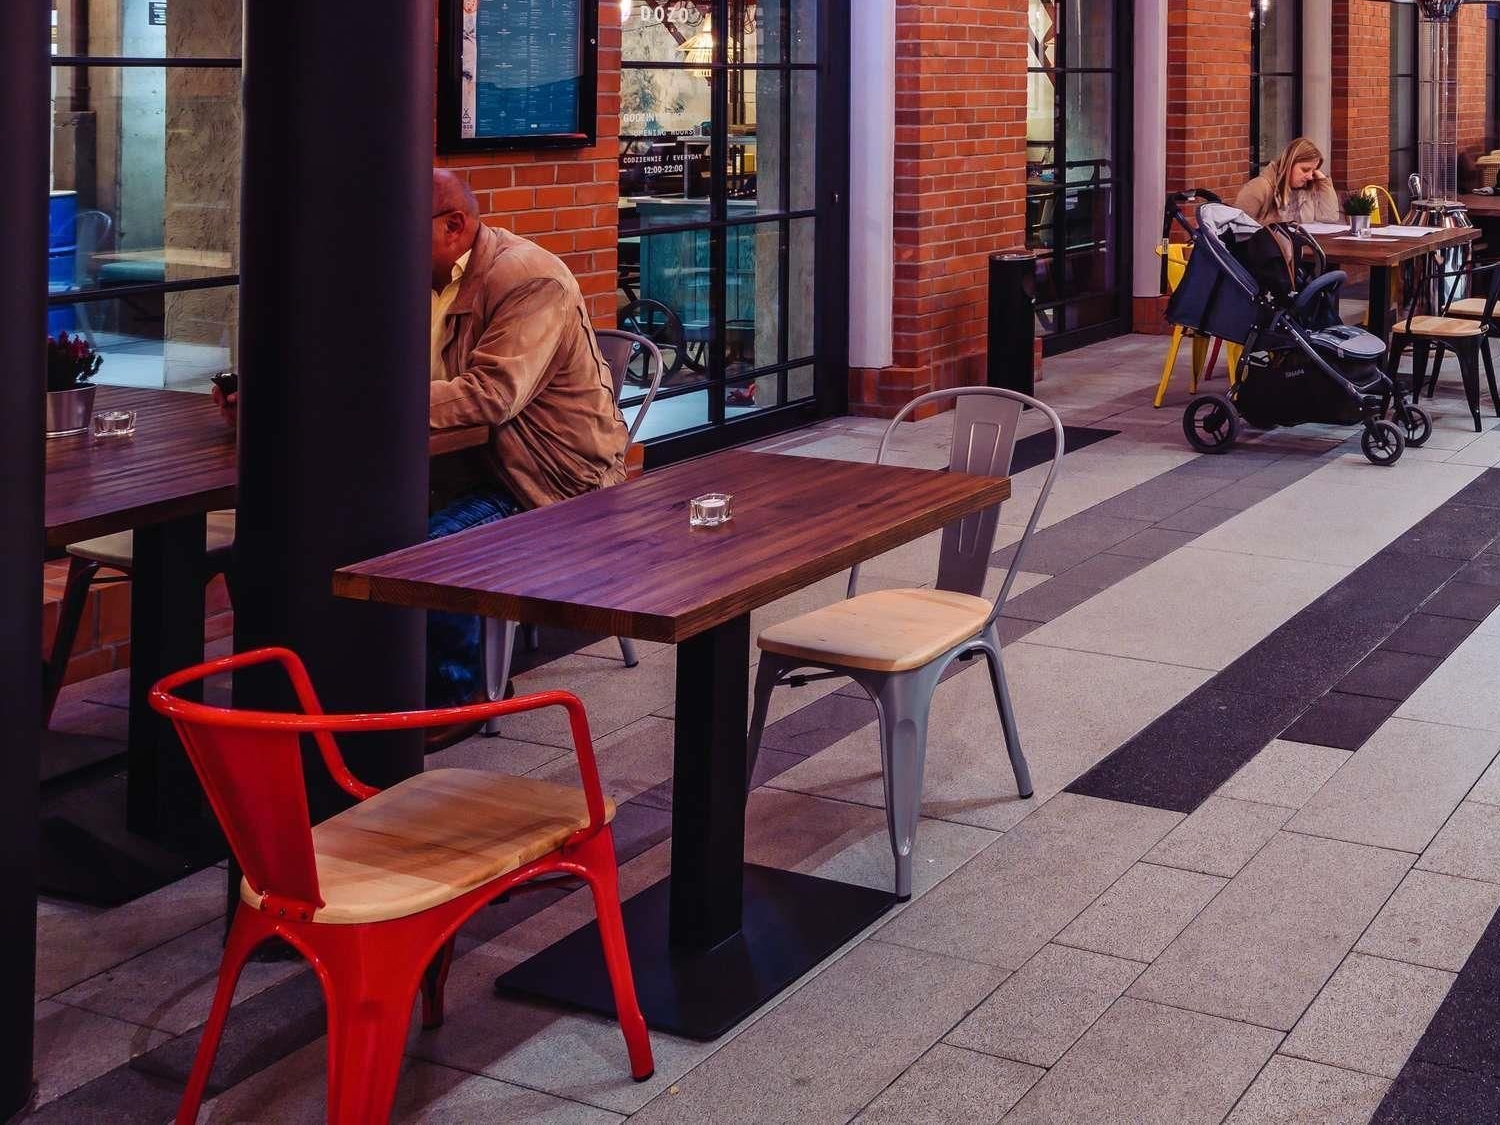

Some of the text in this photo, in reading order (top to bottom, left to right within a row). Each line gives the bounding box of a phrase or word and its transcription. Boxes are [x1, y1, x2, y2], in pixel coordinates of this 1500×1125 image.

[640, 5, 689, 24] DOZO
[623, 155, 662, 164] CODZIENNIE
[643, 164, 684, 175] 12:00-22:00
